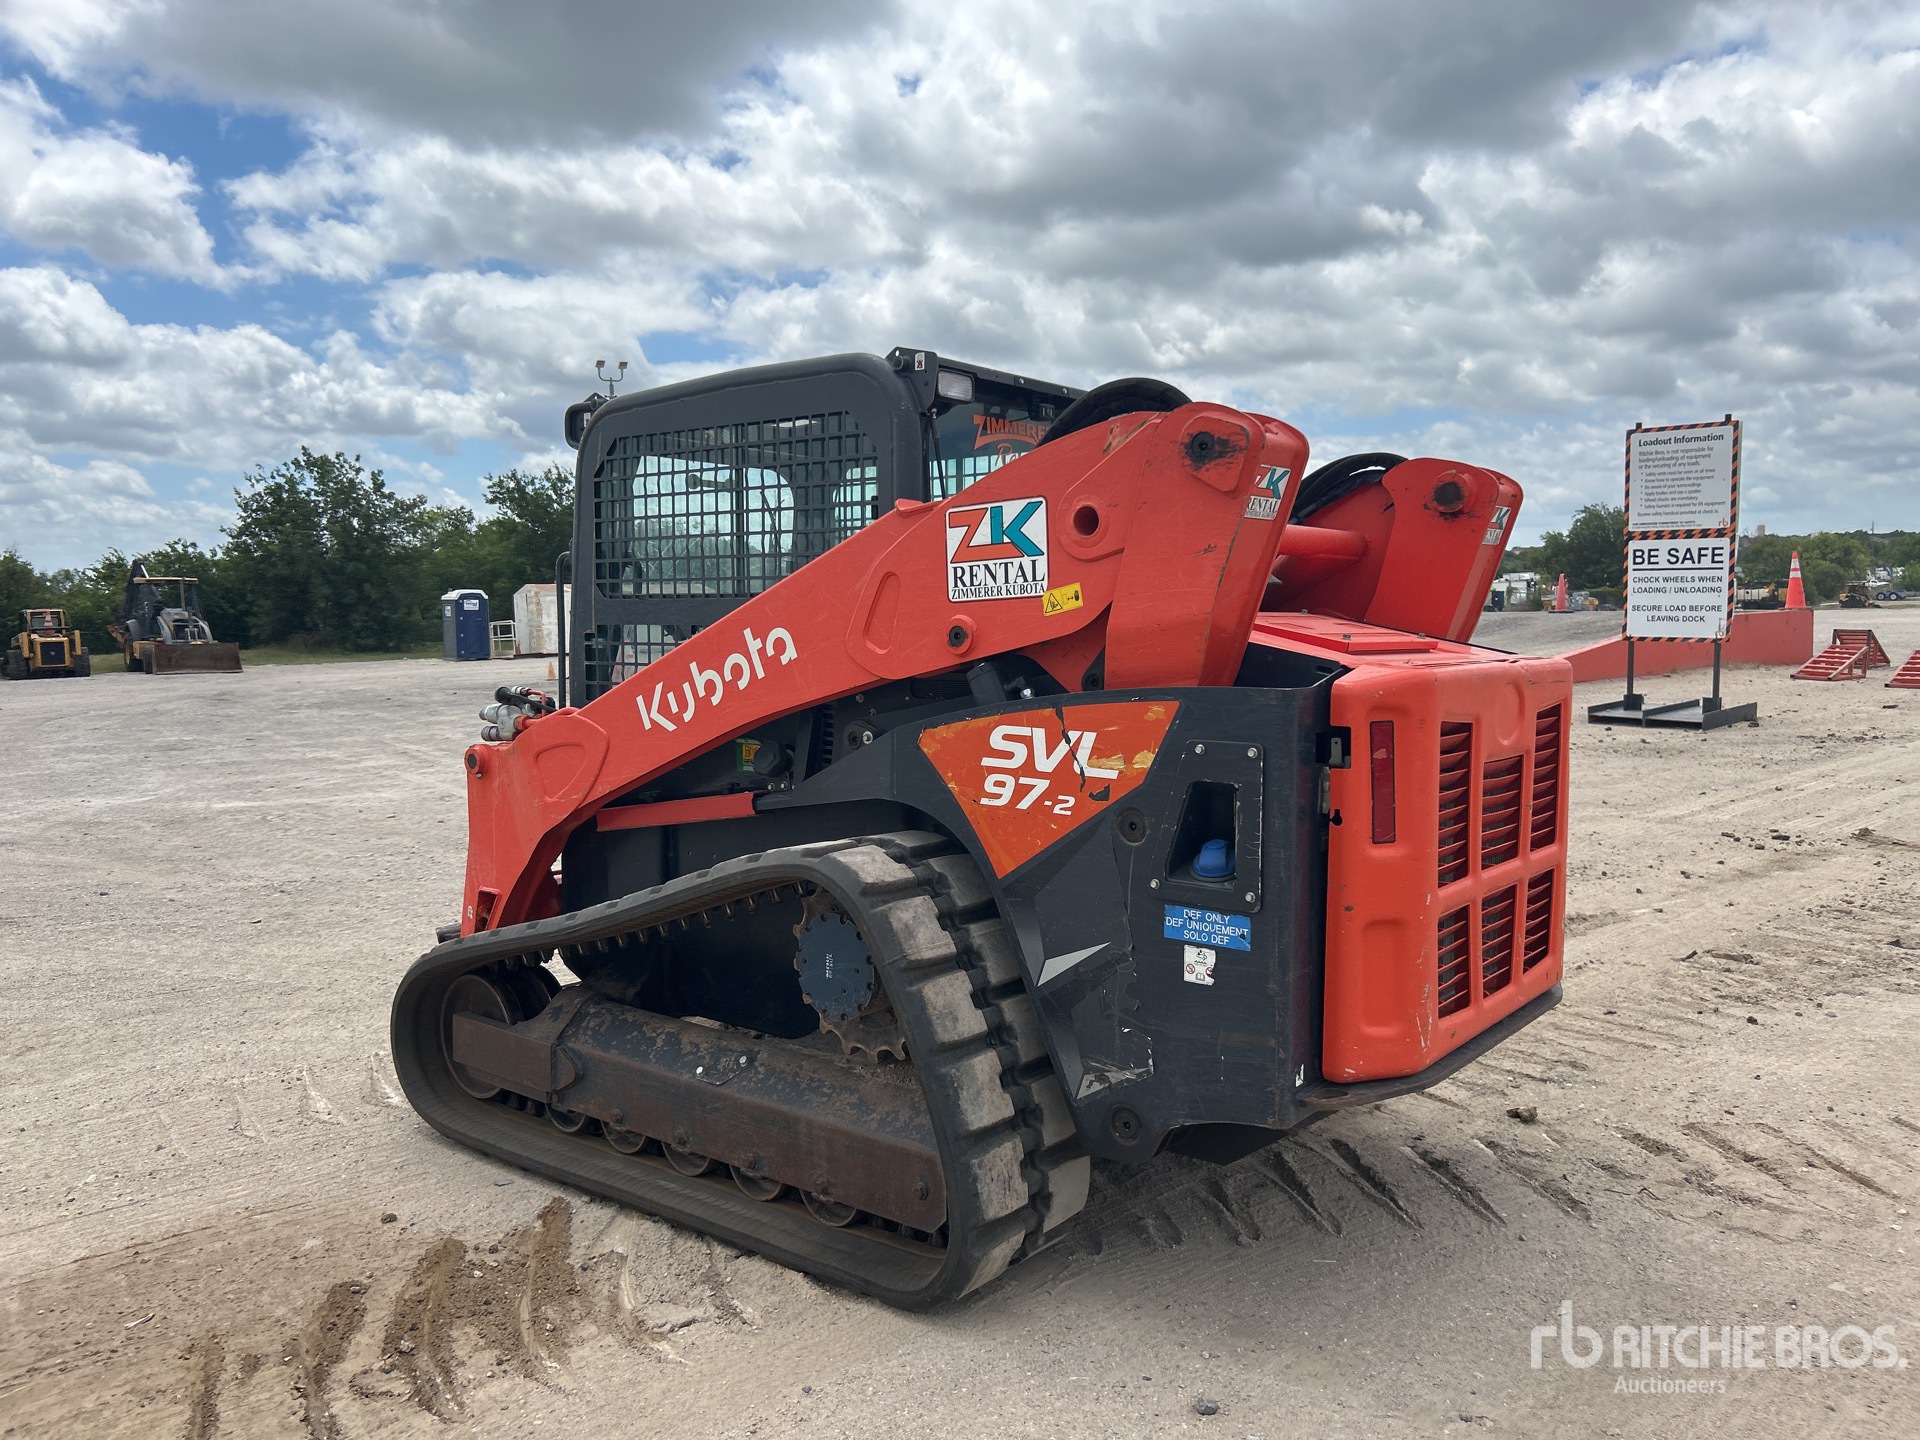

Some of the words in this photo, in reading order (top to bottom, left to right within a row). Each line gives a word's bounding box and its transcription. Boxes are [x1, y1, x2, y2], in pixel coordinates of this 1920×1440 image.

[1639, 437, 1671, 447] Loadout
[1674, 433, 1724, 444] Information
[949, 500, 1045, 564] ZK
[1632, 548, 1659, 565] BE
[1666, 547, 1724, 564] SAFE
[952, 559, 1045, 588] RENTAL
[952, 586, 1003, 599] ZIMMERER
[1005, 583, 1046, 596] KUBOTA
[636, 627, 798, 732] Kubota
[981, 725, 1120, 779] SVL
[980, 774, 1076, 816] 97-2
[1183, 909, 1202, 920] DEF
[1205, 913, 1230, 924] ONLY
[1166, 917, 1184, 927] DEF
[1186, 919, 1248, 937] UNIQUEMENT
[1183, 930, 1208, 942] SOLO
[1211, 934, 1230, 945] DEF
